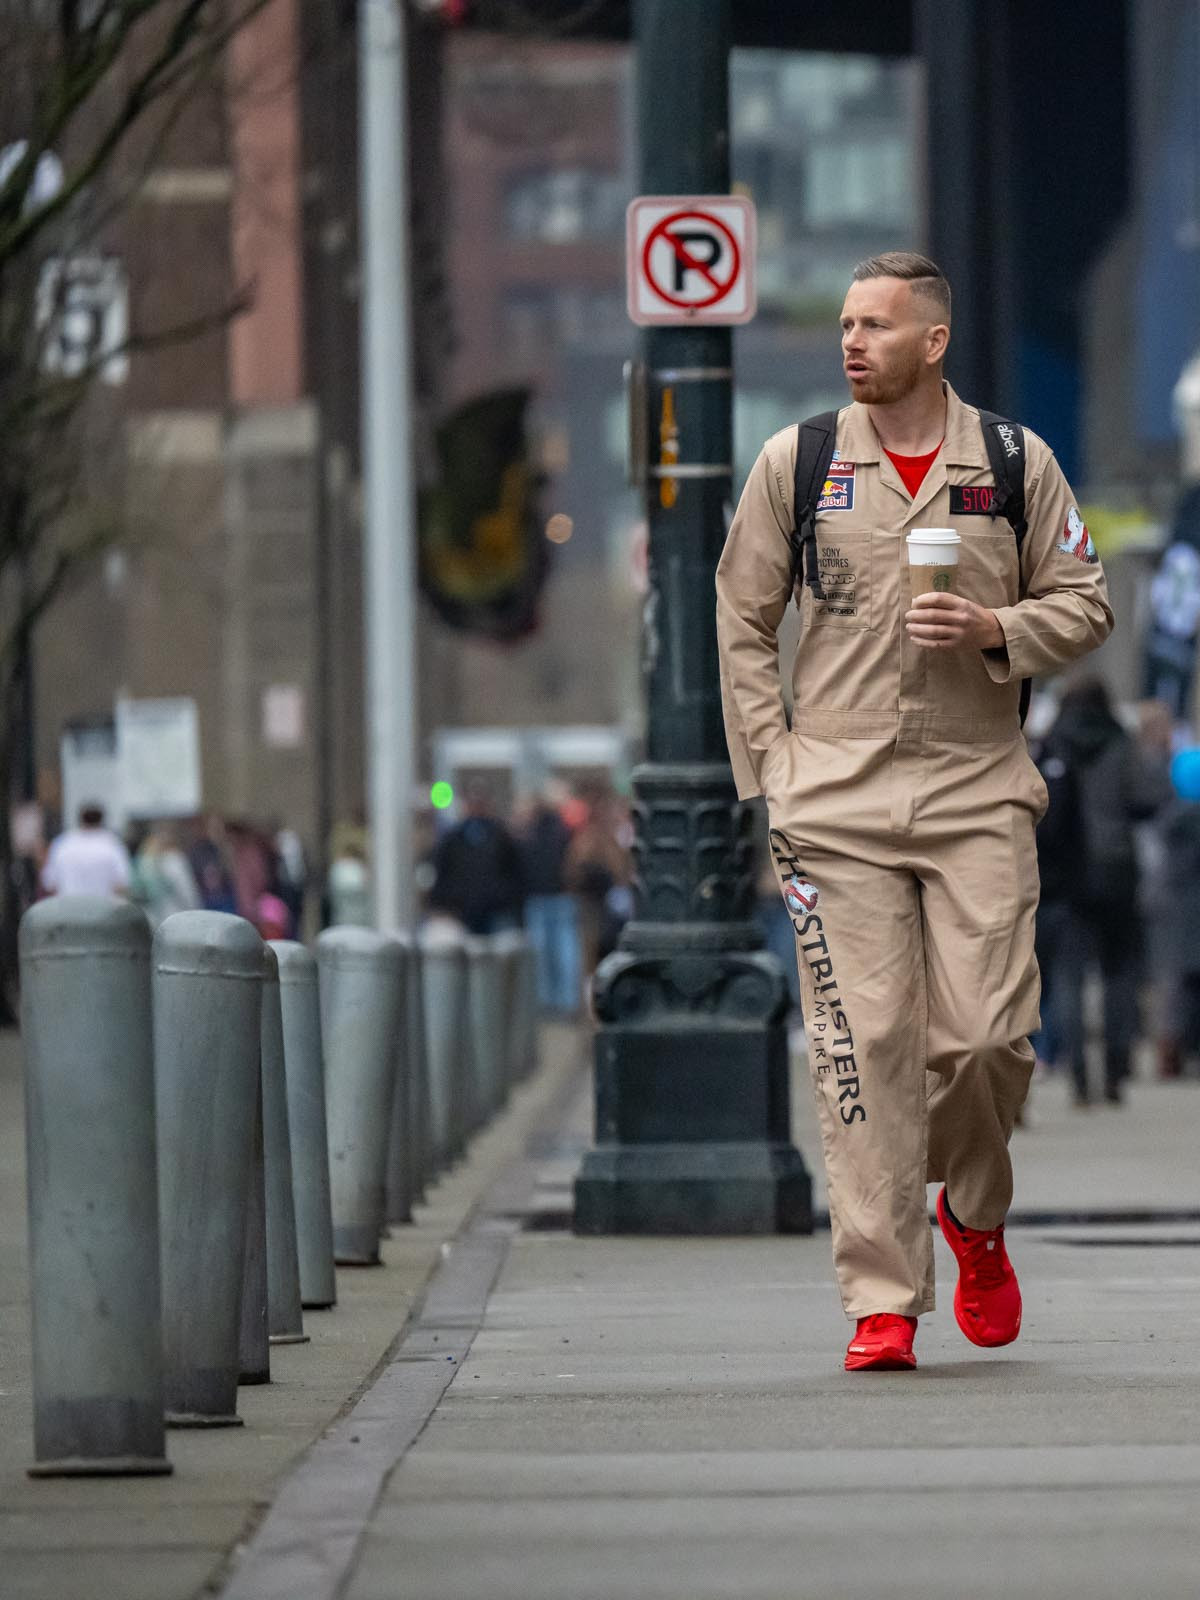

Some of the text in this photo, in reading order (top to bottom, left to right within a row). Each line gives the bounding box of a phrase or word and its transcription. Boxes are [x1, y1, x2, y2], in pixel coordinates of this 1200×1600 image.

[673, 231, 722, 291] P
[828, 495, 848, 507] Bull
[822, 548, 841, 557] SONY
[818, 558, 849, 568] ICTURES
